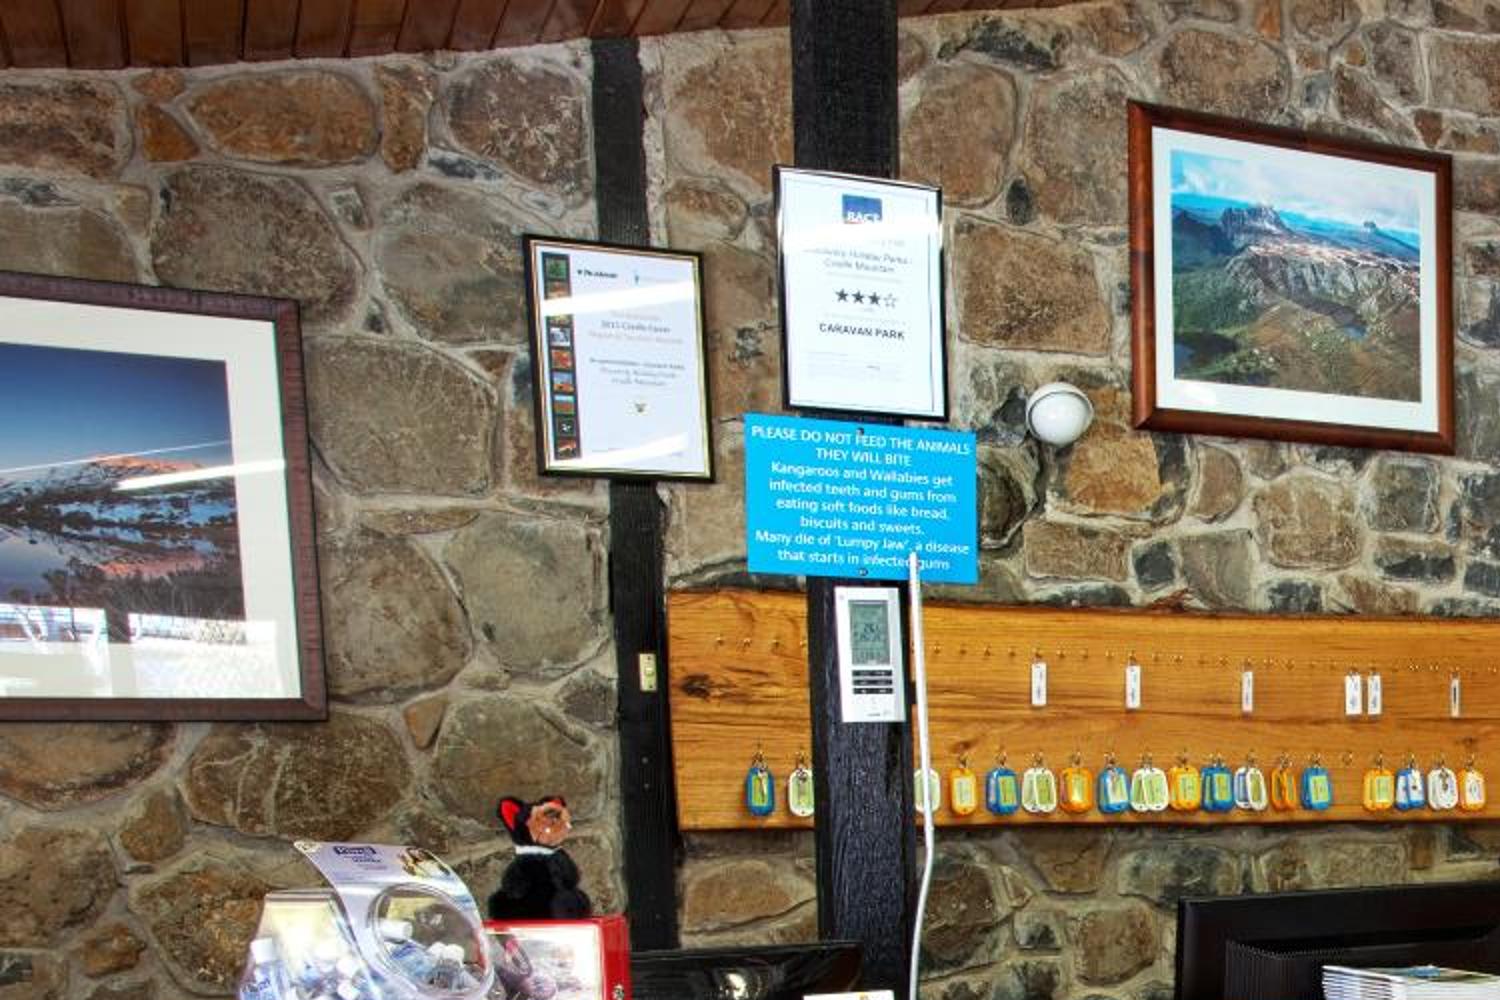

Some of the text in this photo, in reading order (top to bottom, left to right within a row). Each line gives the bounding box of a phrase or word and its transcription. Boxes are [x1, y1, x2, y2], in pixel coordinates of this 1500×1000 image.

[819, 322, 905, 341] CARAVAN PARK
[751, 425, 970, 455] PLEASE DO NOT FEED THE ANIMALS
[816, 447, 912, 467] THEY WILL BITE
[771, 461, 954, 488] Kangaroos and Wallabies get
[769, 478, 957, 503] infected teeth and gums from
[776, 497, 818, 514] eating
[822, 500, 846, 514] soft
[848, 501, 883, 516] foods
[887, 503, 911, 517] like
[800, 515, 925, 535] biscuits and sweets.
[755, 530, 793, 547] Many
[795, 532, 815, 545] die
[818, 533, 831, 546] of
[924, 541, 970, 555] disease
[777, 549, 805, 563] that
[809, 550, 845, 565] starts
[848, 553, 859, 566] in
